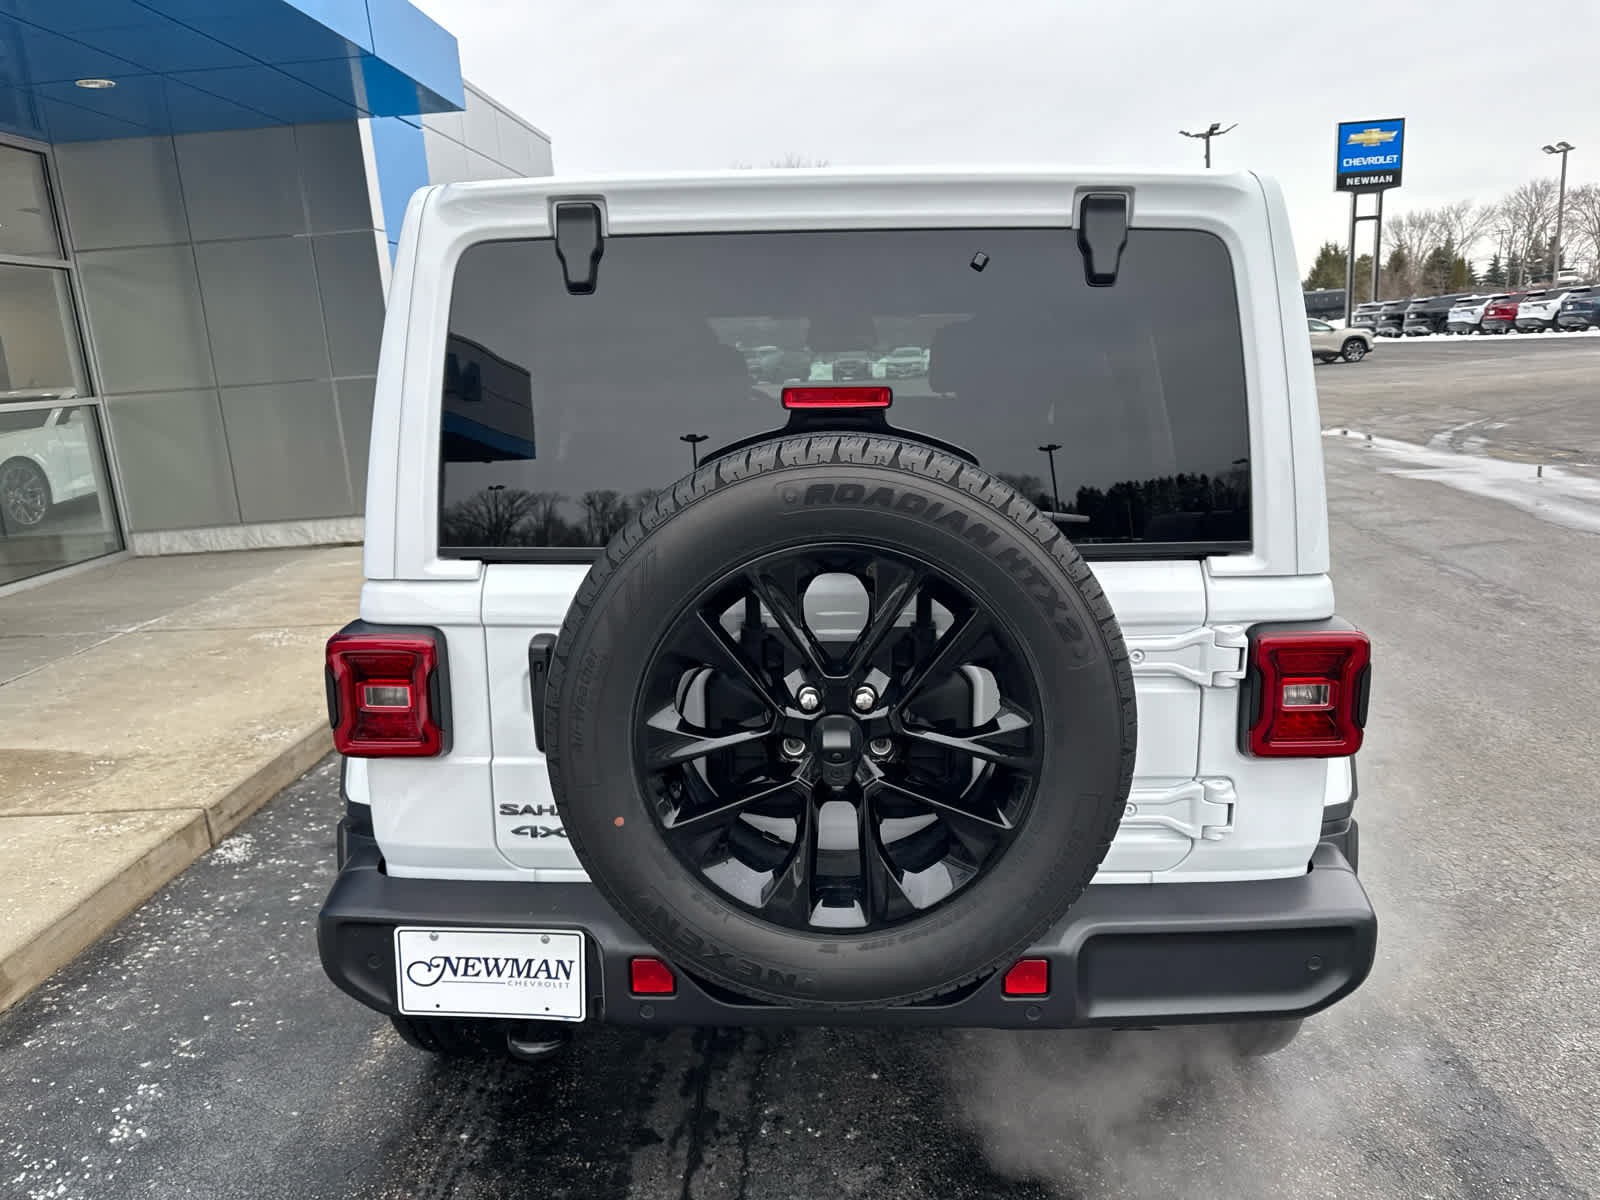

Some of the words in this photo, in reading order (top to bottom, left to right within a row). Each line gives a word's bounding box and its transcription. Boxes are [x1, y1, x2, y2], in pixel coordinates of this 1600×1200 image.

[1343, 154, 1399, 167] CHEVROLET
[1346, 175, 1393, 186] NEWMAN
[803, 483, 1000, 548] ROADIAN
[499, 803, 560, 816] SAH
[652, 905, 798, 986] NEXEN
[407, 955, 576, 987] NEWMAN
[507, 979, 571, 990] CHEVROLET
